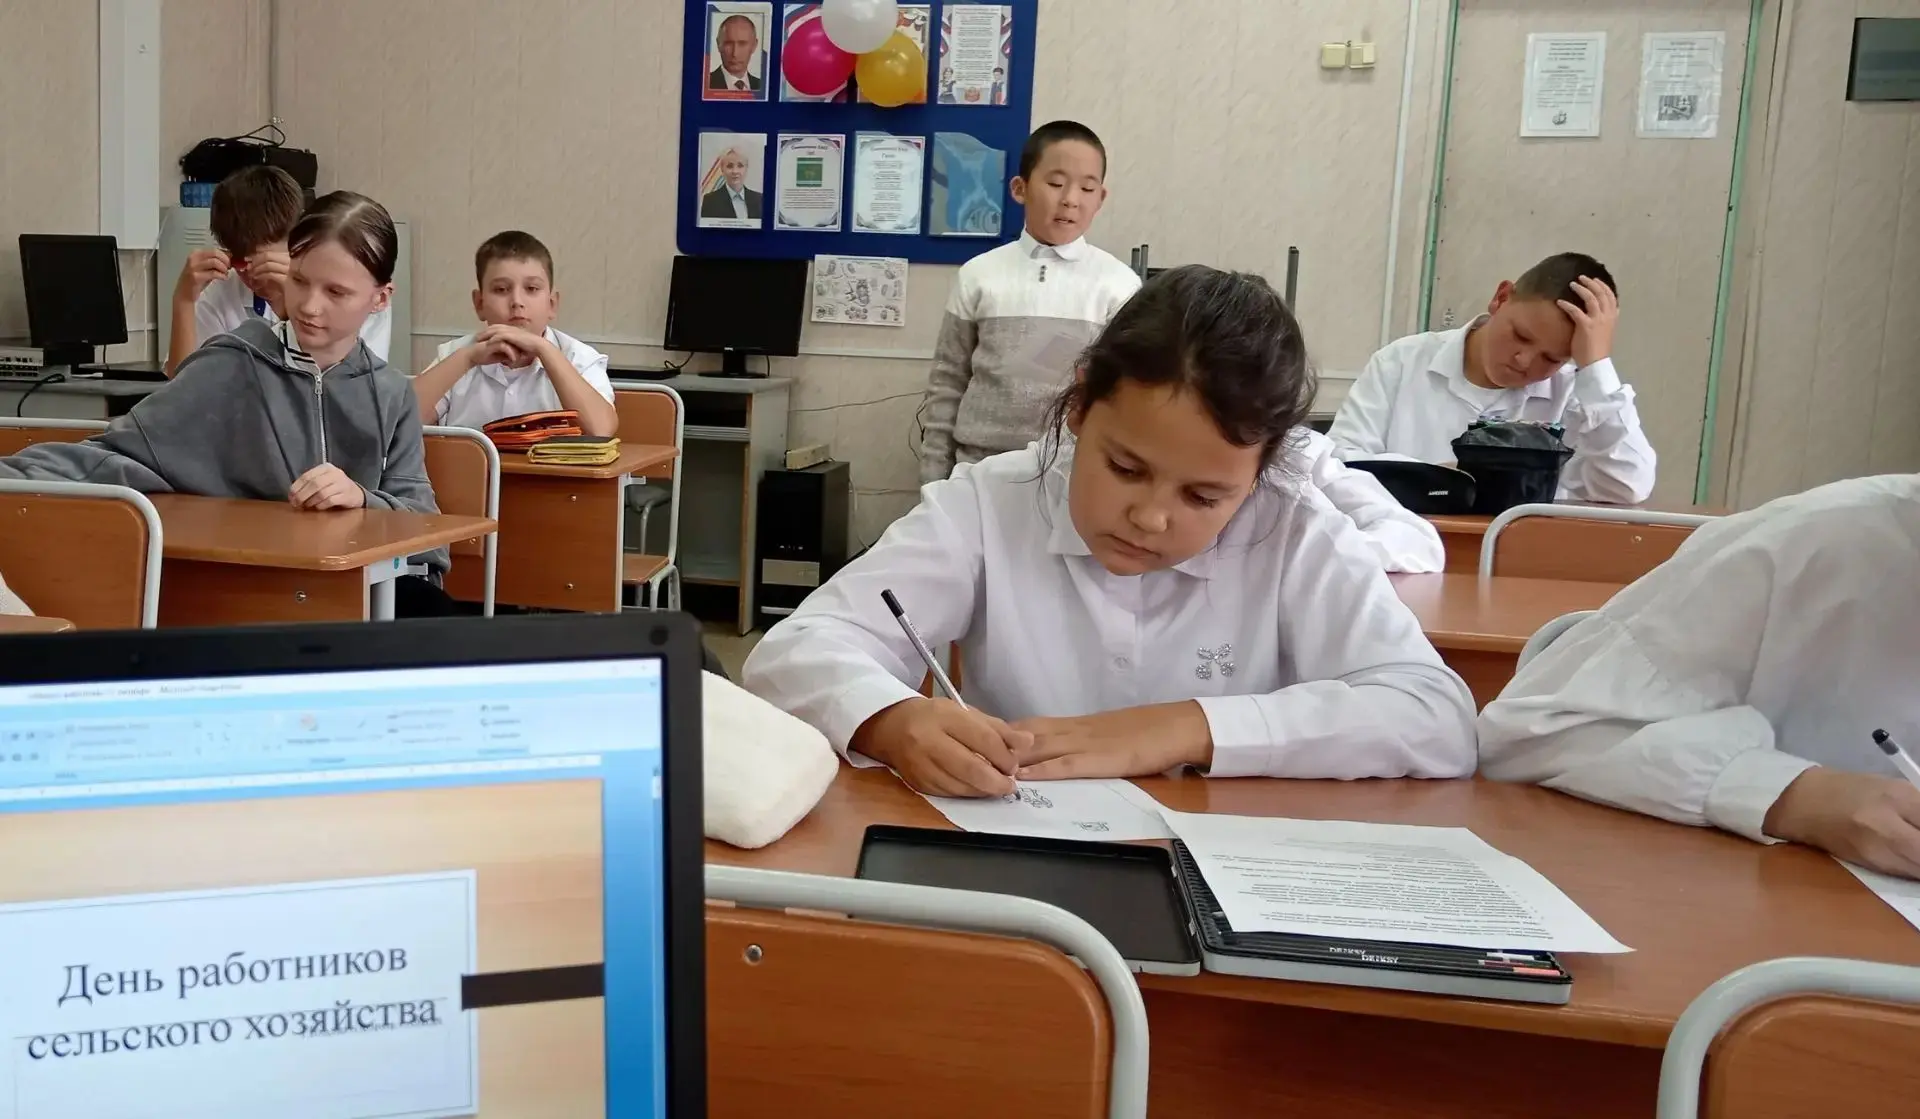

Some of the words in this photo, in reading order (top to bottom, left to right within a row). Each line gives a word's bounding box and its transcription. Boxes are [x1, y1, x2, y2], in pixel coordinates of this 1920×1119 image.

[58, 964, 164, 1007] День
[177, 947, 408, 999] работников
[28, 1018, 232, 1060] сельского
[244, 998, 438, 1040] хозяйства
